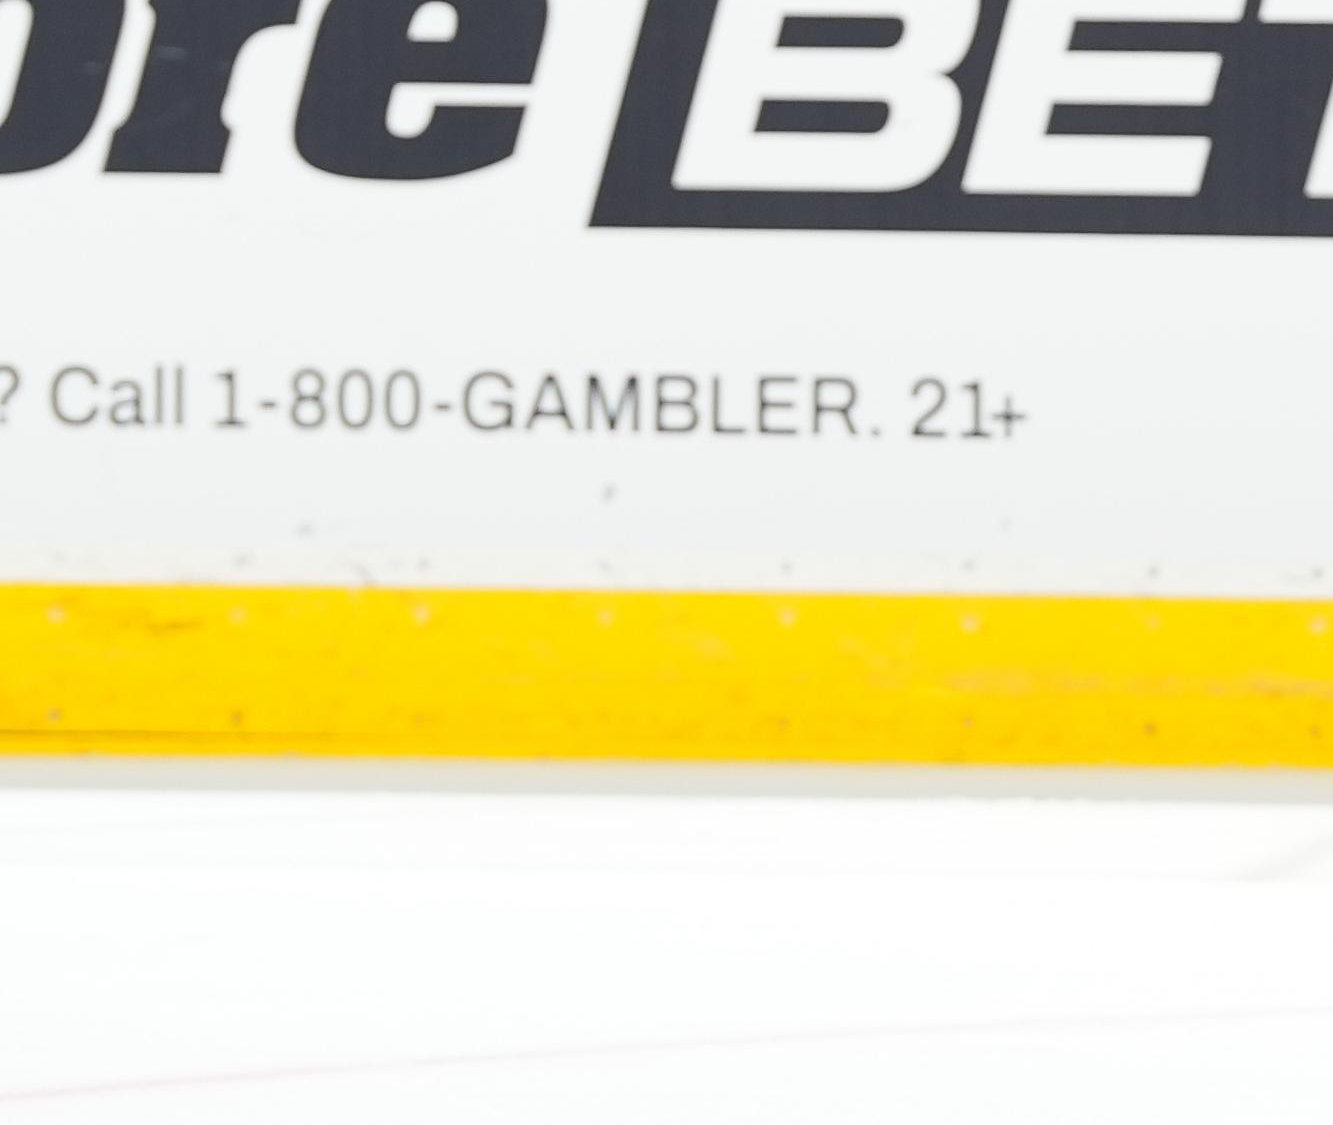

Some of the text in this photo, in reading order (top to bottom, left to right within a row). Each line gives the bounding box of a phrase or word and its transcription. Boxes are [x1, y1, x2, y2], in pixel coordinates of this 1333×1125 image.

[48, 364, 185, 428] Call
[215, 367, 882, 438] 1-800-GAMBLER.
[909, 376, 1027, 441] 21+
